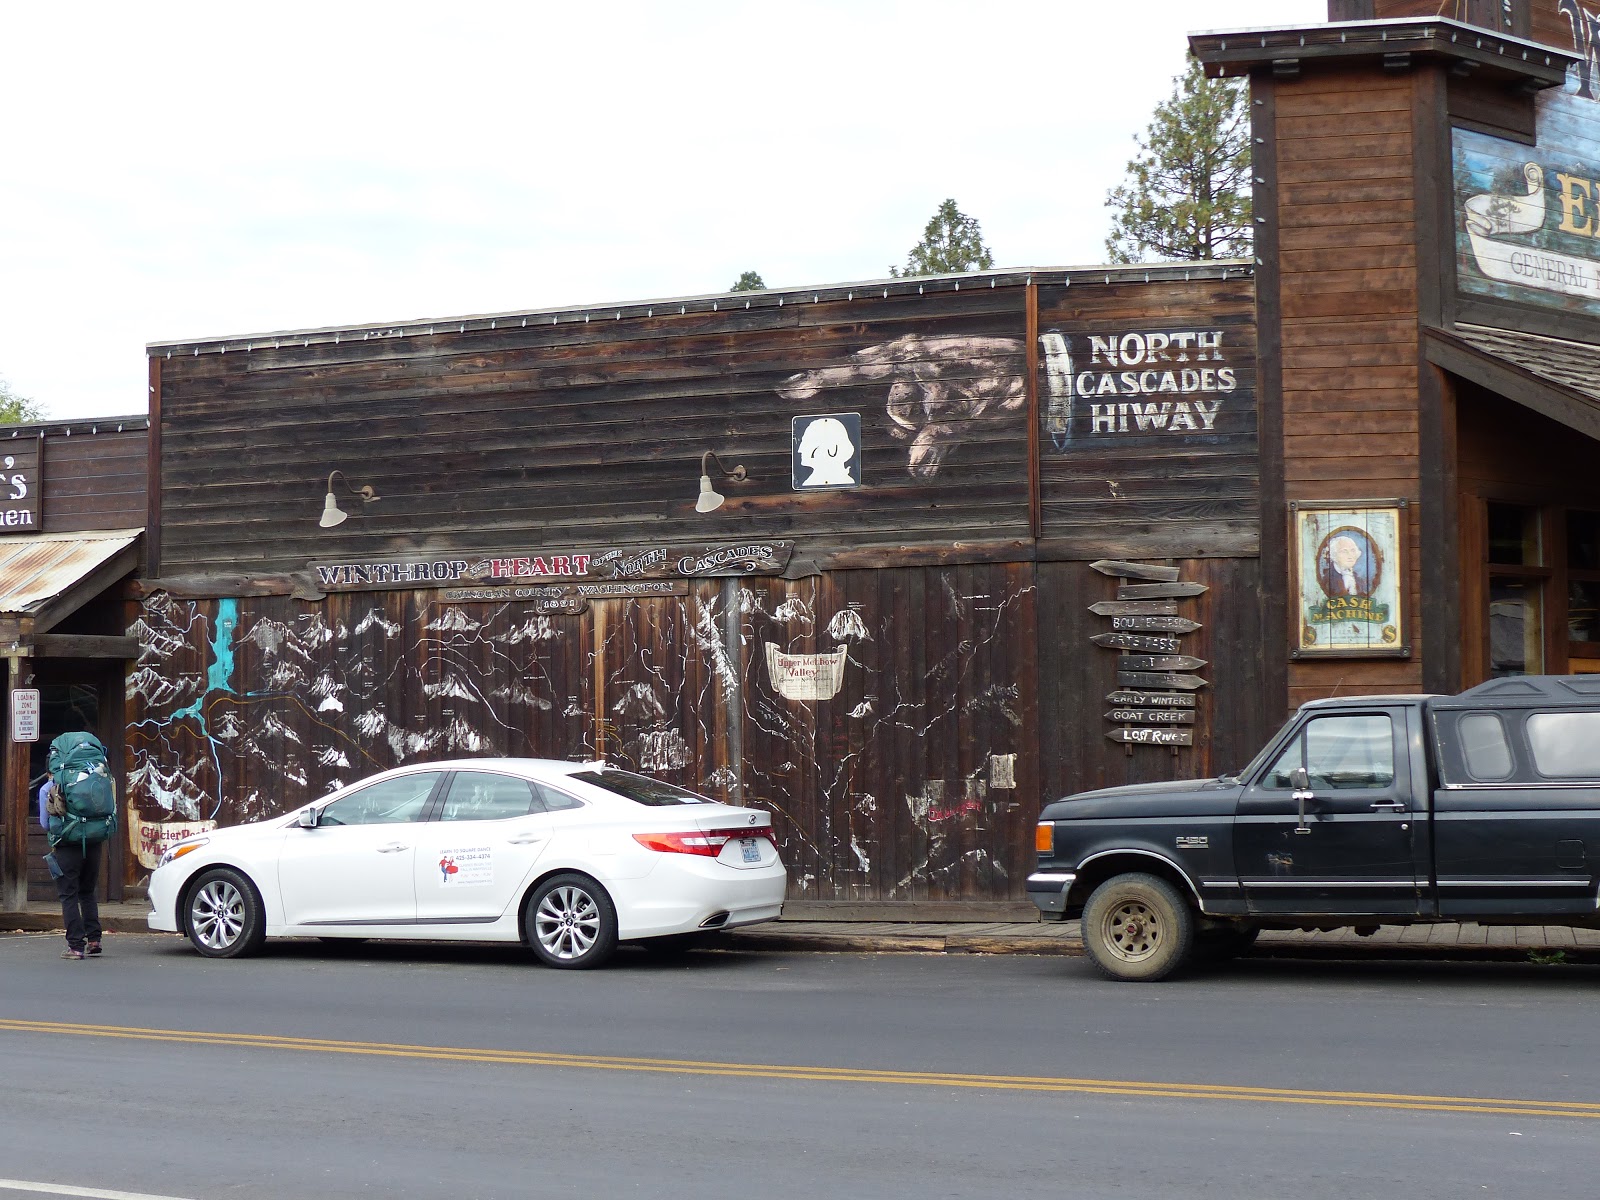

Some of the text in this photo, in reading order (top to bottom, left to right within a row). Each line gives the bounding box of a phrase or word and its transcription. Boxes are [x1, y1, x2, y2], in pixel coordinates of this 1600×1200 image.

[1556, 173, 1600, 240] E
[1510, 251, 1588, 289] GENERAL
[1087, 331, 1225, 367] NORTH
[1076, 366, 1238, 399] CASCADES
[1090, 399, 1225, 434] HIWAY
[316, 560, 469, 585] WINTHROP
[490, 554, 591, 579] HEART
[612, 549, 667, 580] NORTH
[677, 545, 773, 575] CASCADES
[445, 582, 674, 600] OKANOGAN COUNTY WASHINGTON
[1326, 596, 1373, 610] CASH
[1312, 609, 1384, 622] MACHINE
[777, 658, 801, 669] Upper
[789, 668, 820, 678] Valley
[1113, 695, 1193, 705] EARLY WINTERS
[1113, 711, 1186, 722] GOAT CREEK
[1123, 729, 1152, 742] LOST
[141, 826, 181, 841] Glacier
